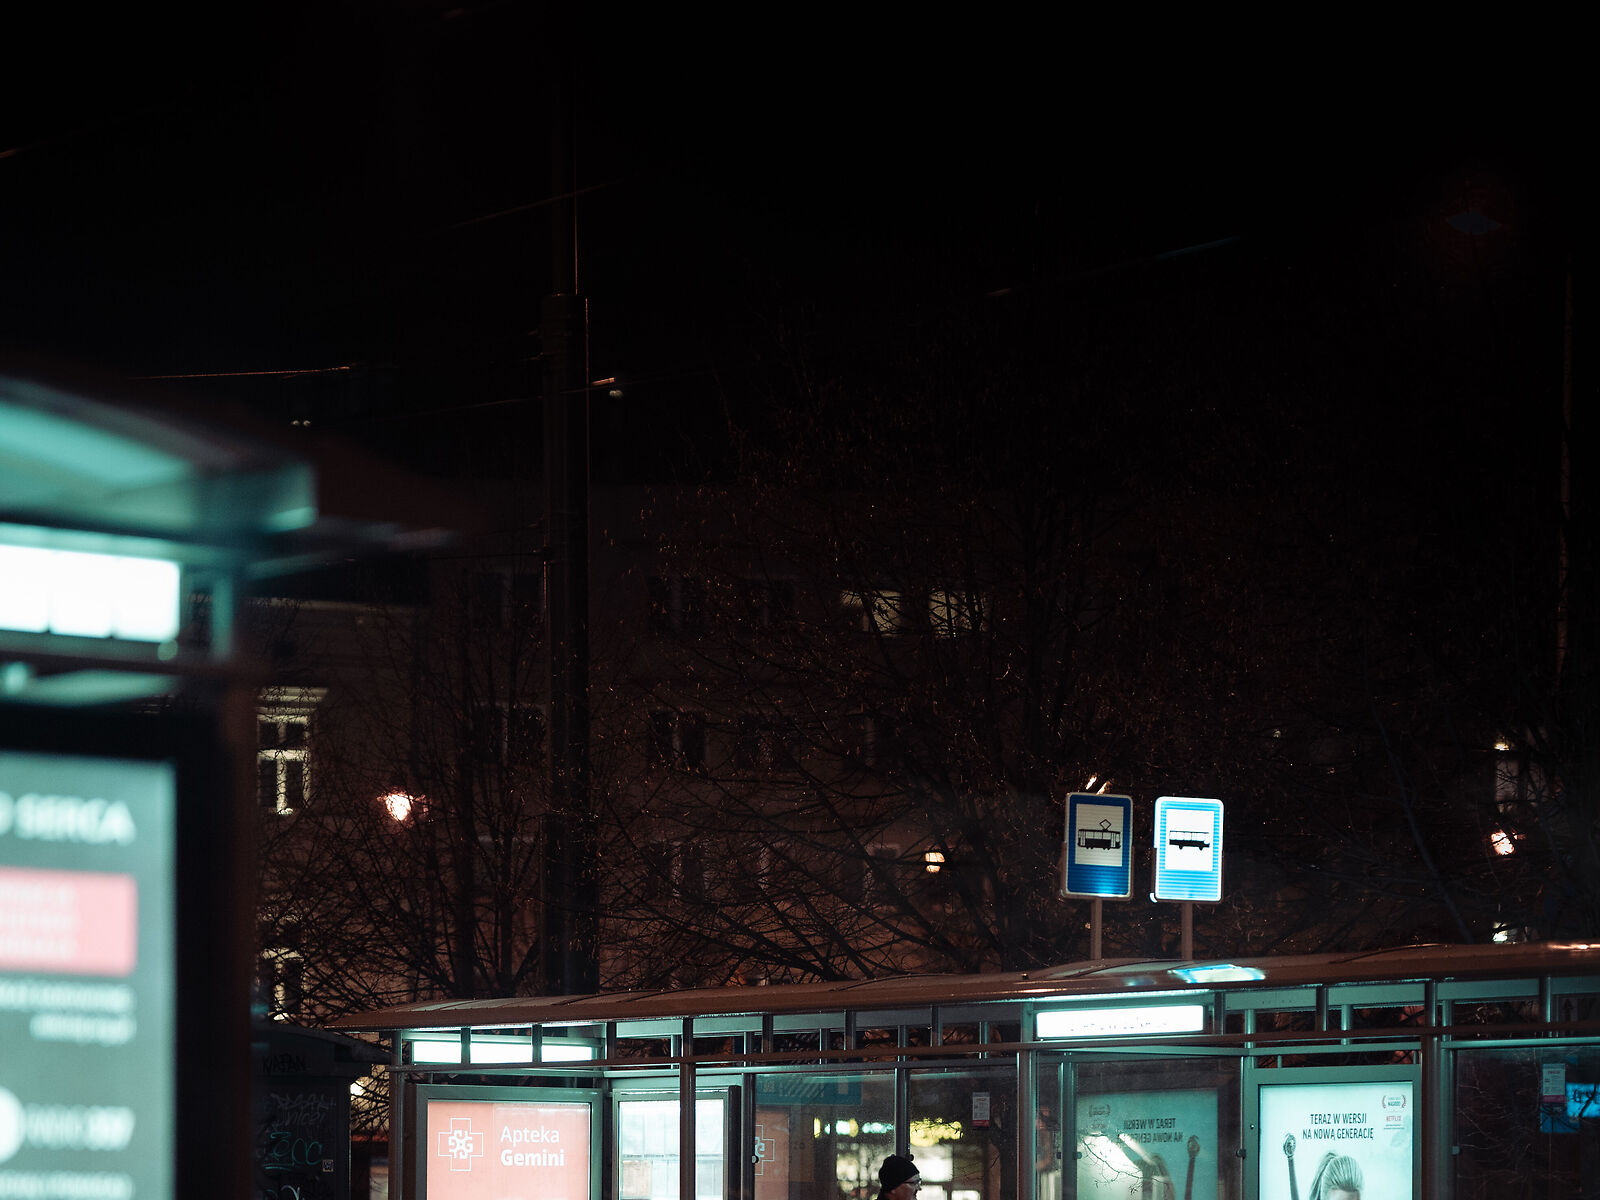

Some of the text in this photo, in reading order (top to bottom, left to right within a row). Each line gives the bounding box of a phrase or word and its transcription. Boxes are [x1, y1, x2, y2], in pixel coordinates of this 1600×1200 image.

[1310, 1113, 1367, 1125] TERAZ W WERSJI
[500, 1126, 560, 1147] Apteka
[1303, 1128, 1374, 1141] NA NOWĄ GENERACJĘ
[500, 1149, 565, 1167] Gemini
